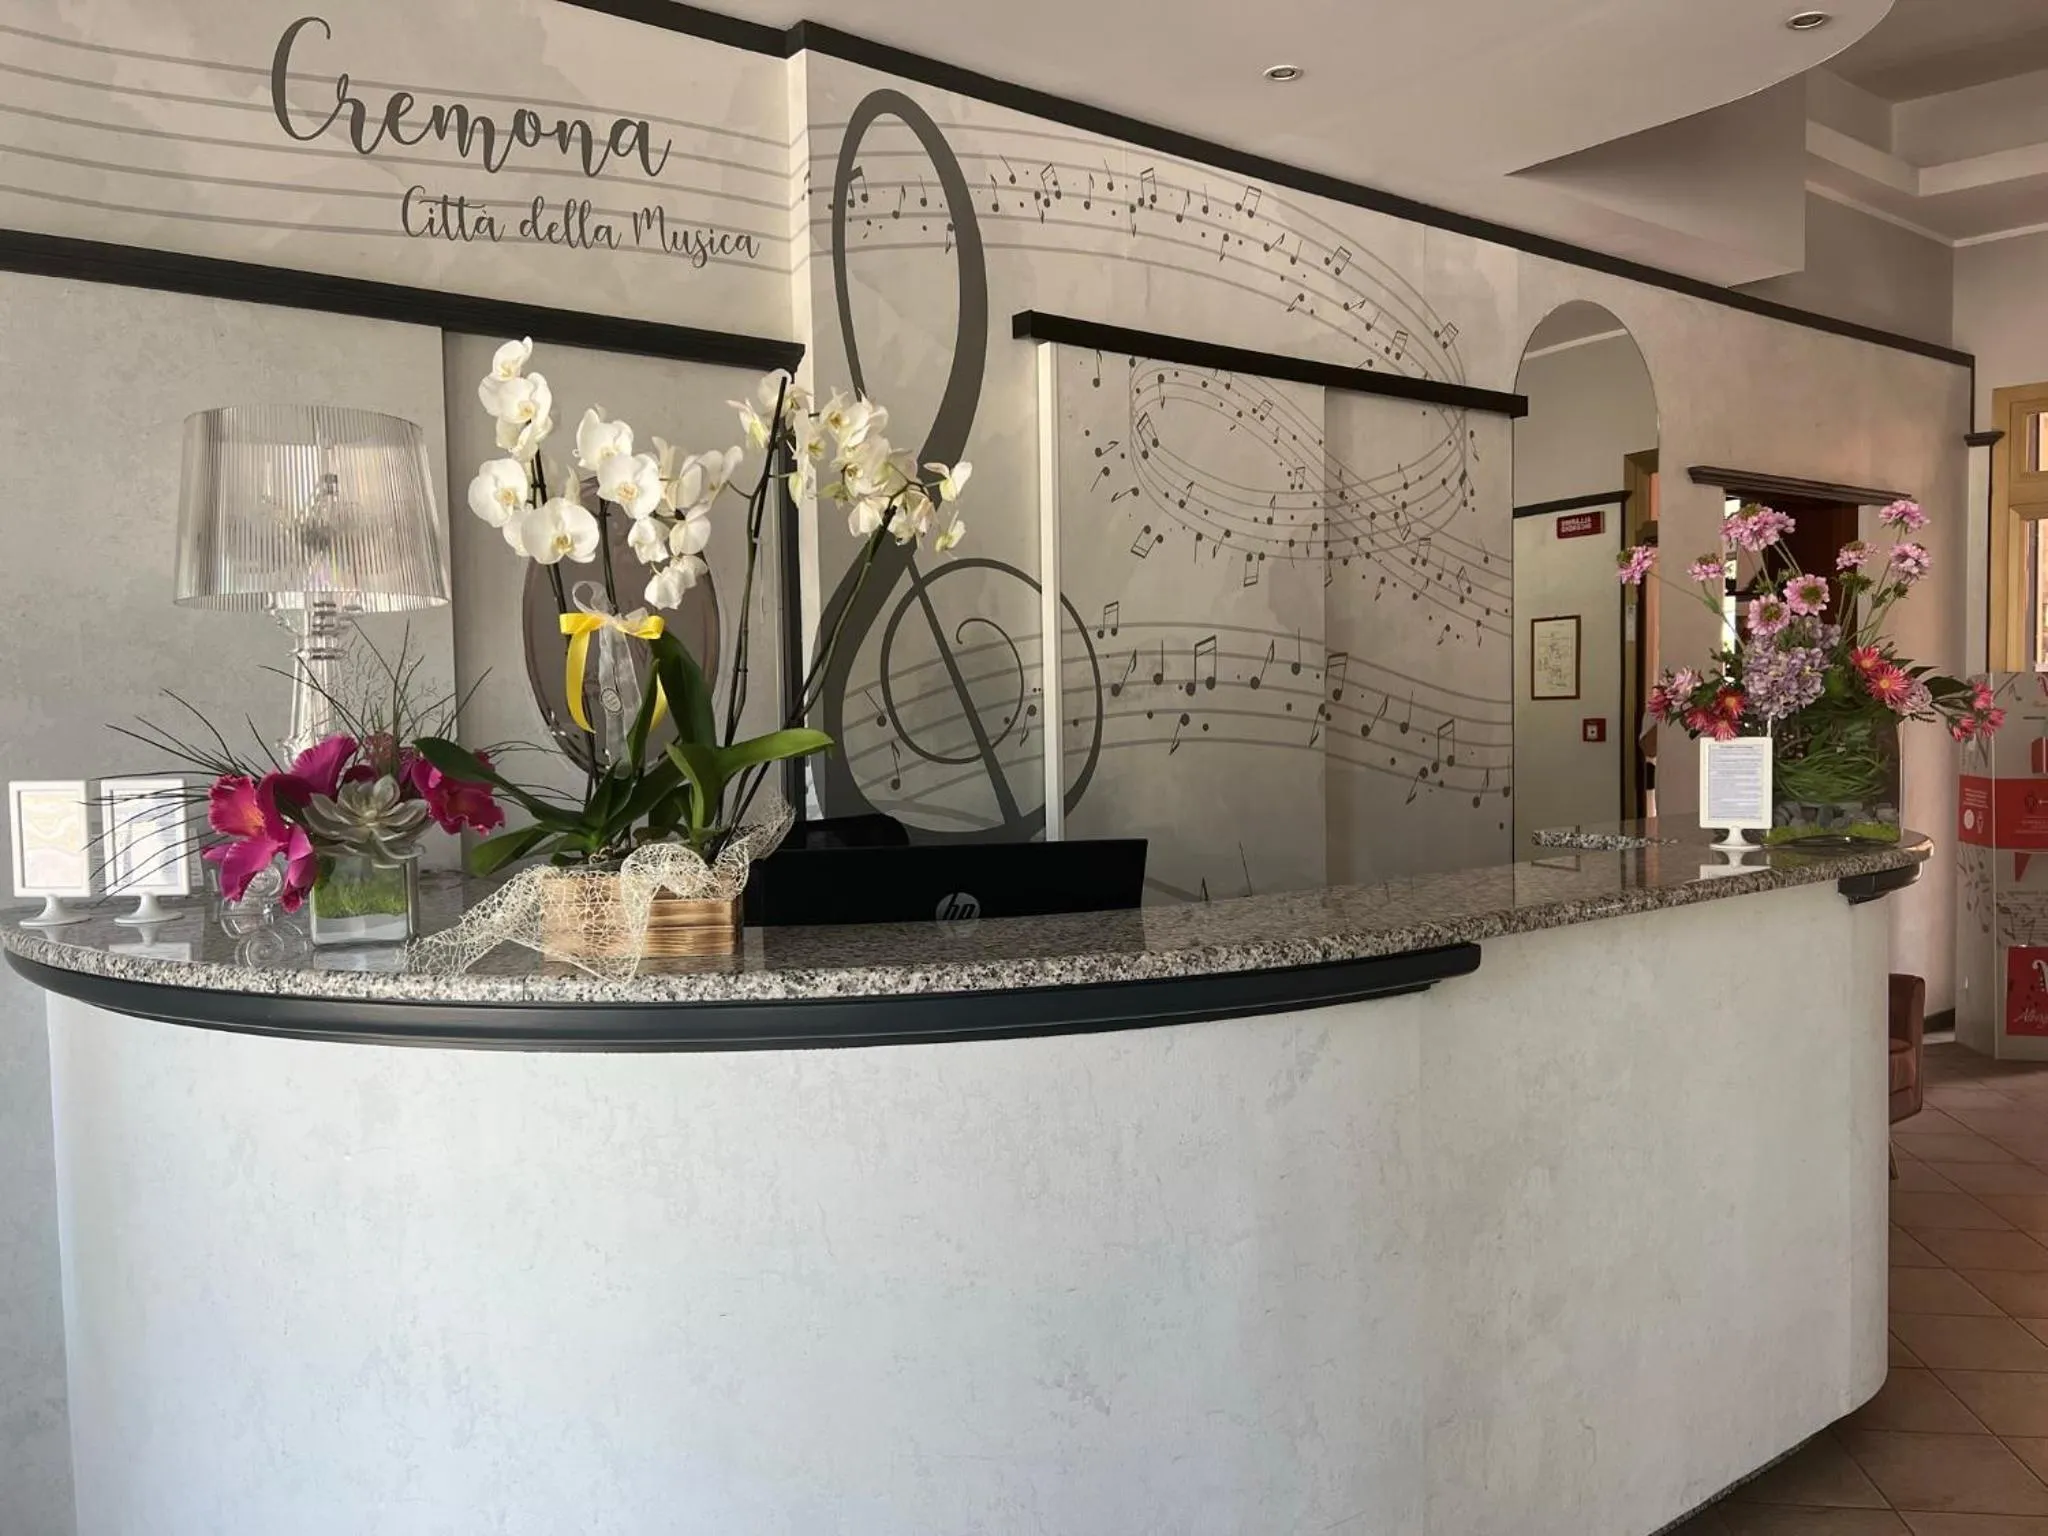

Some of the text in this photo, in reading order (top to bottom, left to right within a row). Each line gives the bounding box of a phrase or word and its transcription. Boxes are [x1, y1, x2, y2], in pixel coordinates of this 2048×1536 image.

[271, 16, 672, 178] Cremona
[402, 185, 761, 269] Città della Musica
